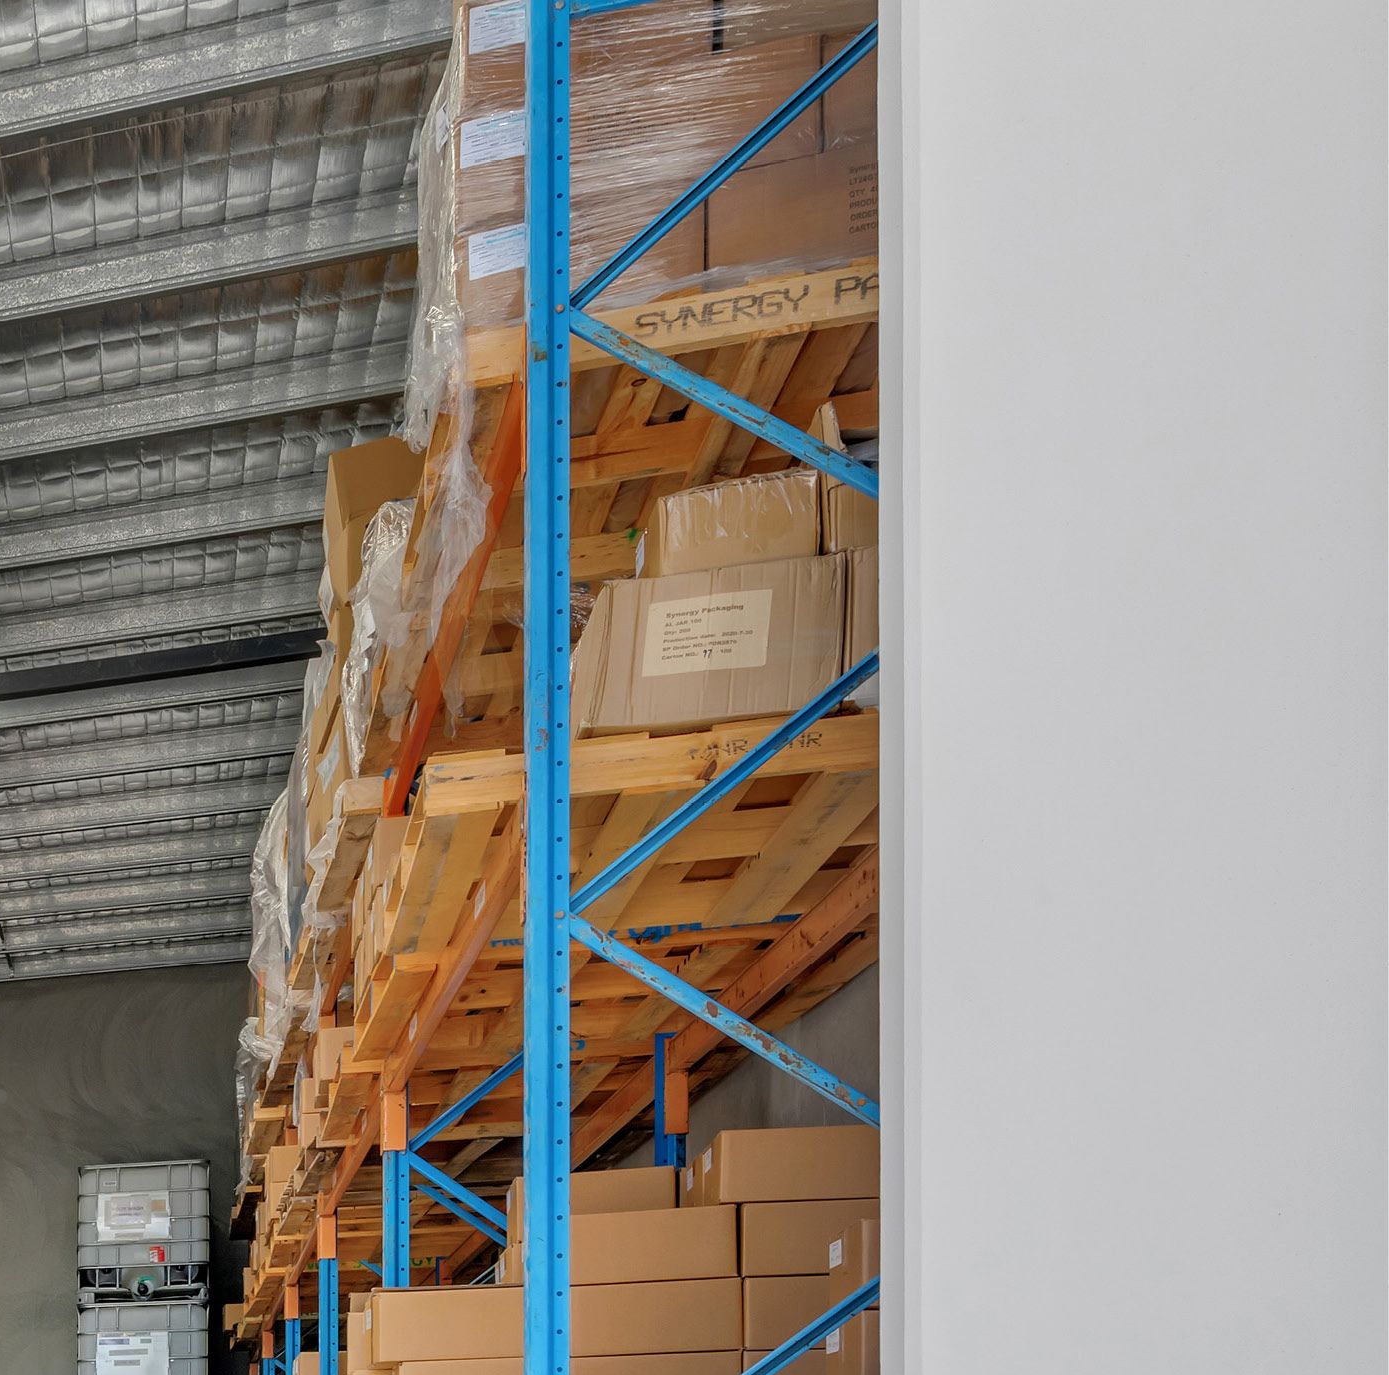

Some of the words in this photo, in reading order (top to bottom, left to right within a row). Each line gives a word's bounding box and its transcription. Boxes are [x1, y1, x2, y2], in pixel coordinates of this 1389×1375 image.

[634, 284, 810, 337] SYNERGY
[665, 609, 699, 619] Synergy
[702, 604, 744, 614] Packaging
